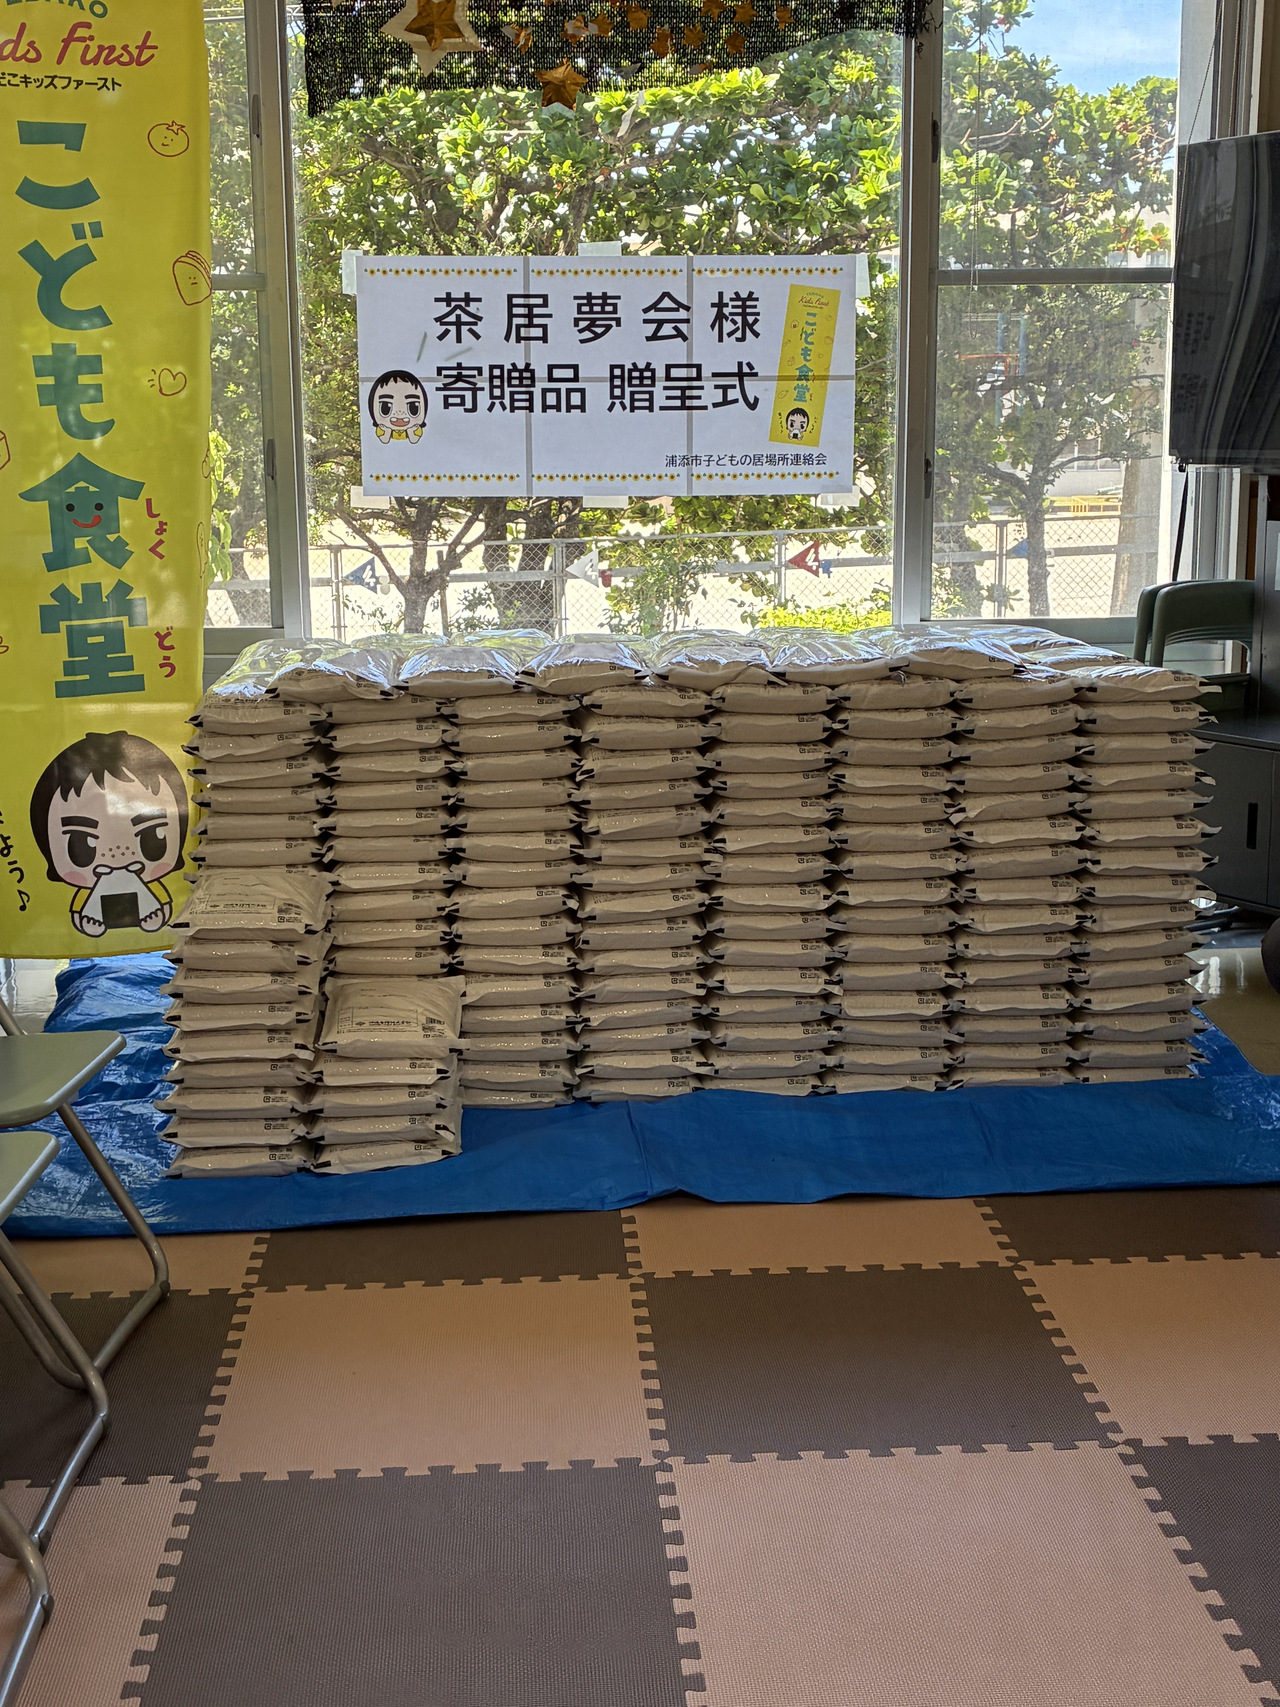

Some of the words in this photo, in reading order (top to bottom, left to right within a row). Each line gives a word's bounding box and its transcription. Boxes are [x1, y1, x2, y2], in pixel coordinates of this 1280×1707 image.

[56, 21, 159, 67] First
[433, 290, 761, 344] 茶居夢会様
[15, 120, 148, 698] こども食堂
[435, 362, 586, 413] 寄贈品
[607, 361, 760, 413] 贈呈式
[665, 453, 827, 467] 浦添市子どもの居場所連絡会
[145, 497, 168, 560] しょく
[153, 625, 176, 678] どう
